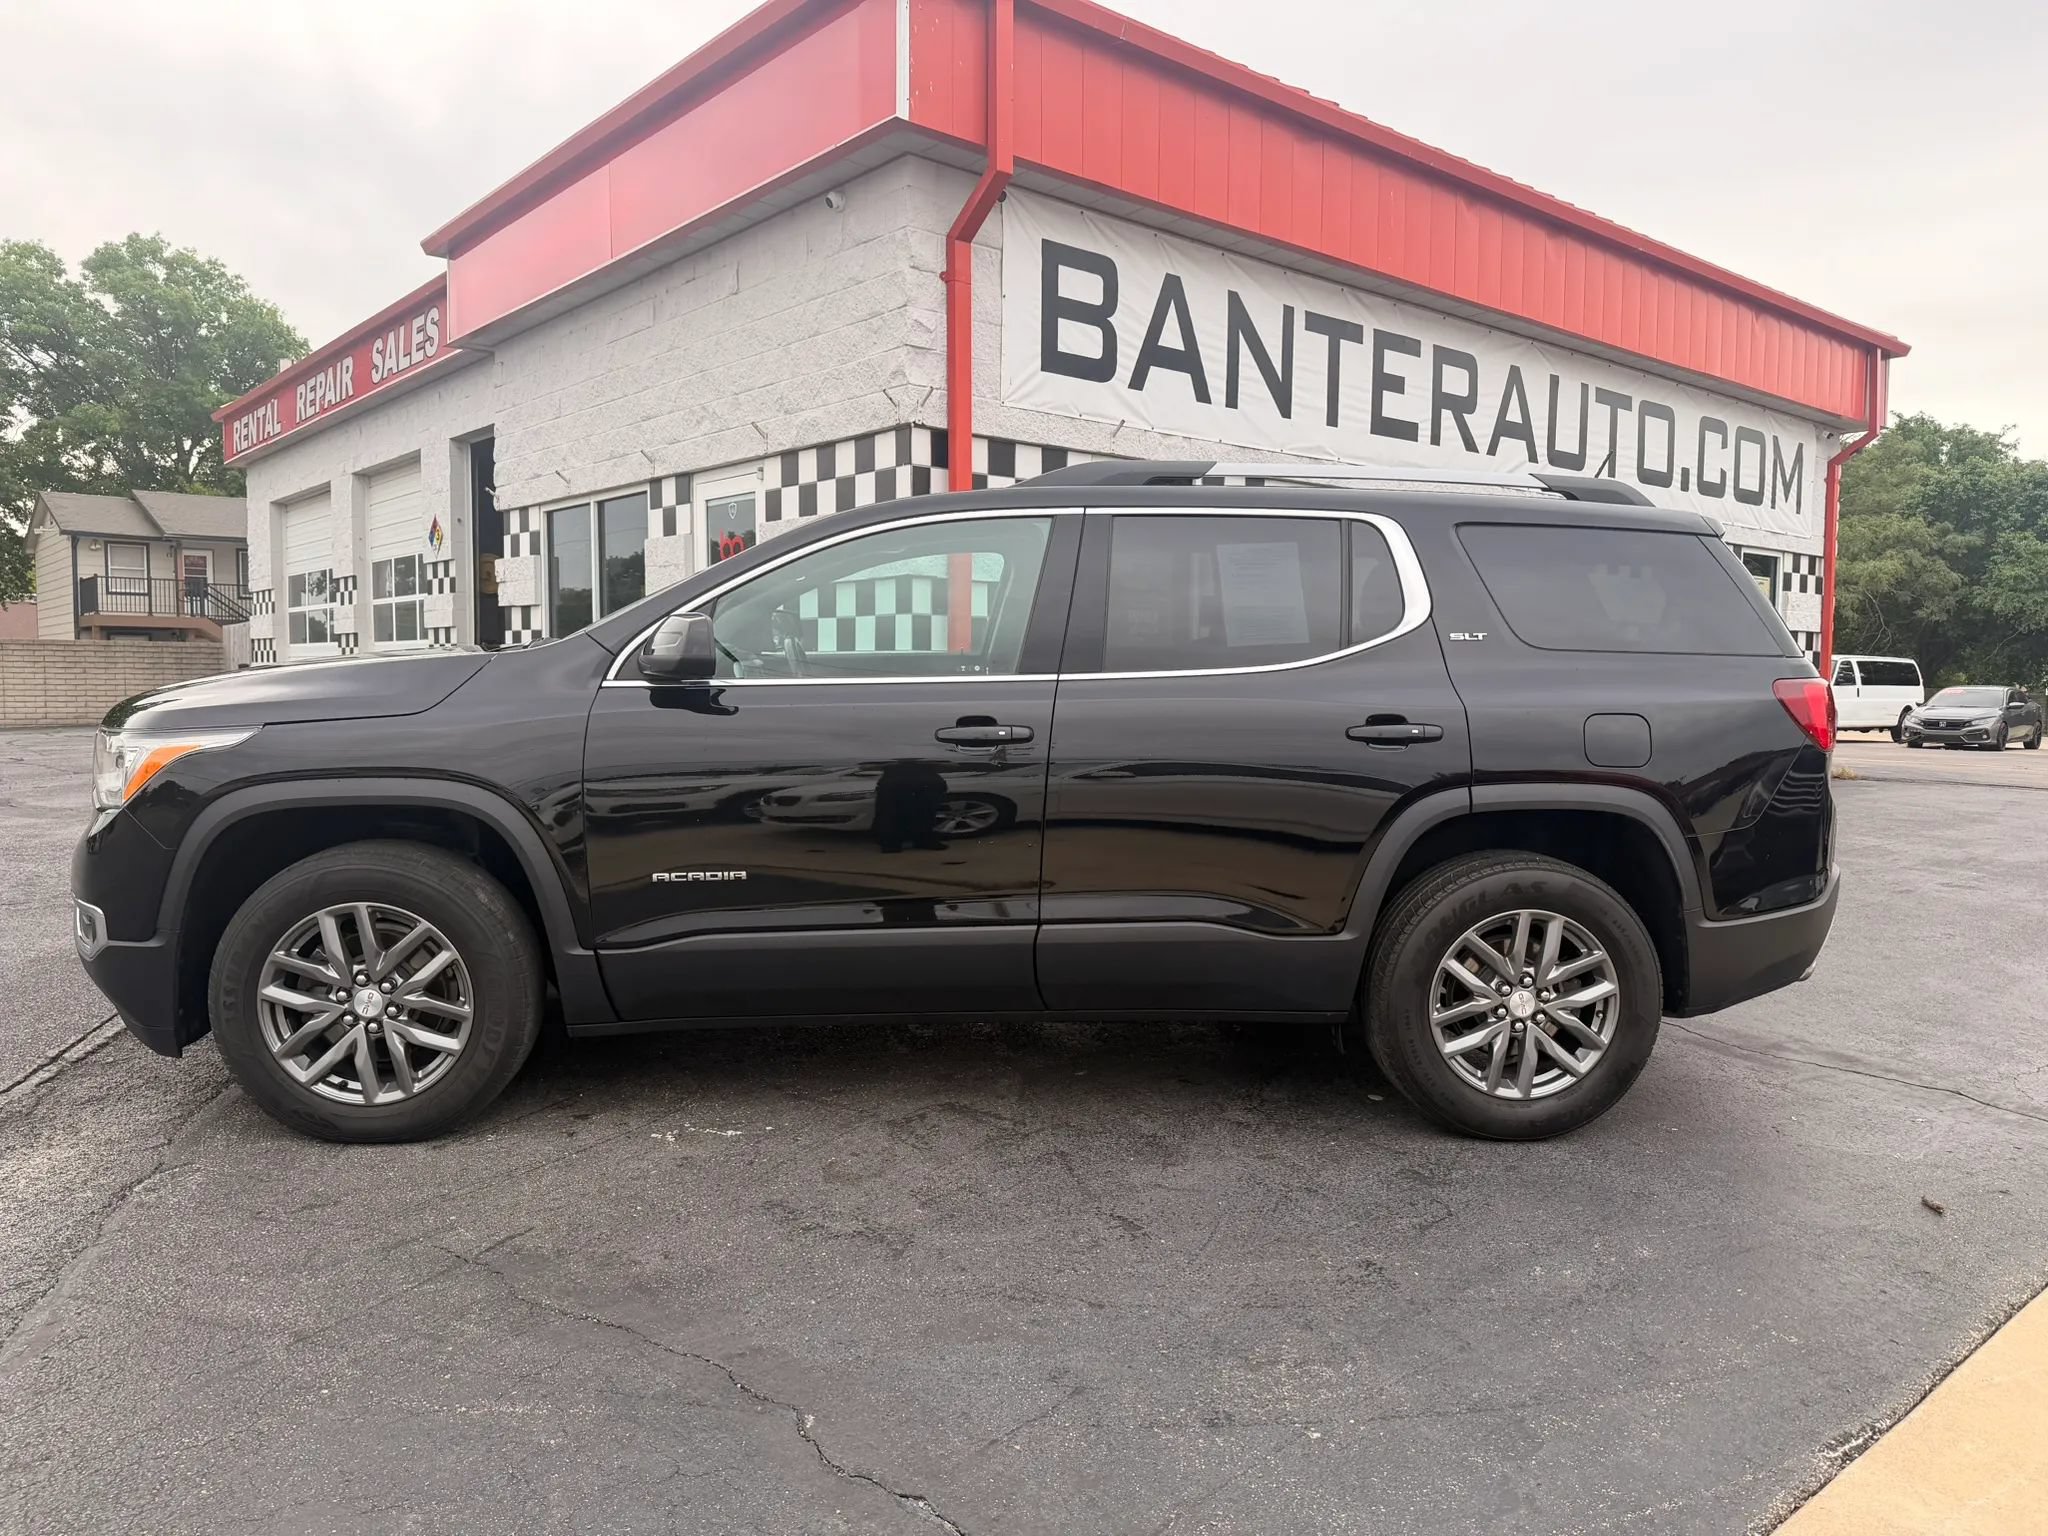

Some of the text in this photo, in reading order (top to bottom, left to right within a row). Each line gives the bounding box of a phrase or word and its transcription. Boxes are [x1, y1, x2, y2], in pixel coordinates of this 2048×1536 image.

[233, 307, 439, 454] RENTAL REPAIR SALES
[1040, 238, 1804, 515] BANTERAUTO.COM
[1449, 632, 1488, 641] SLT
[652, 871, 747, 882] ACADIA
